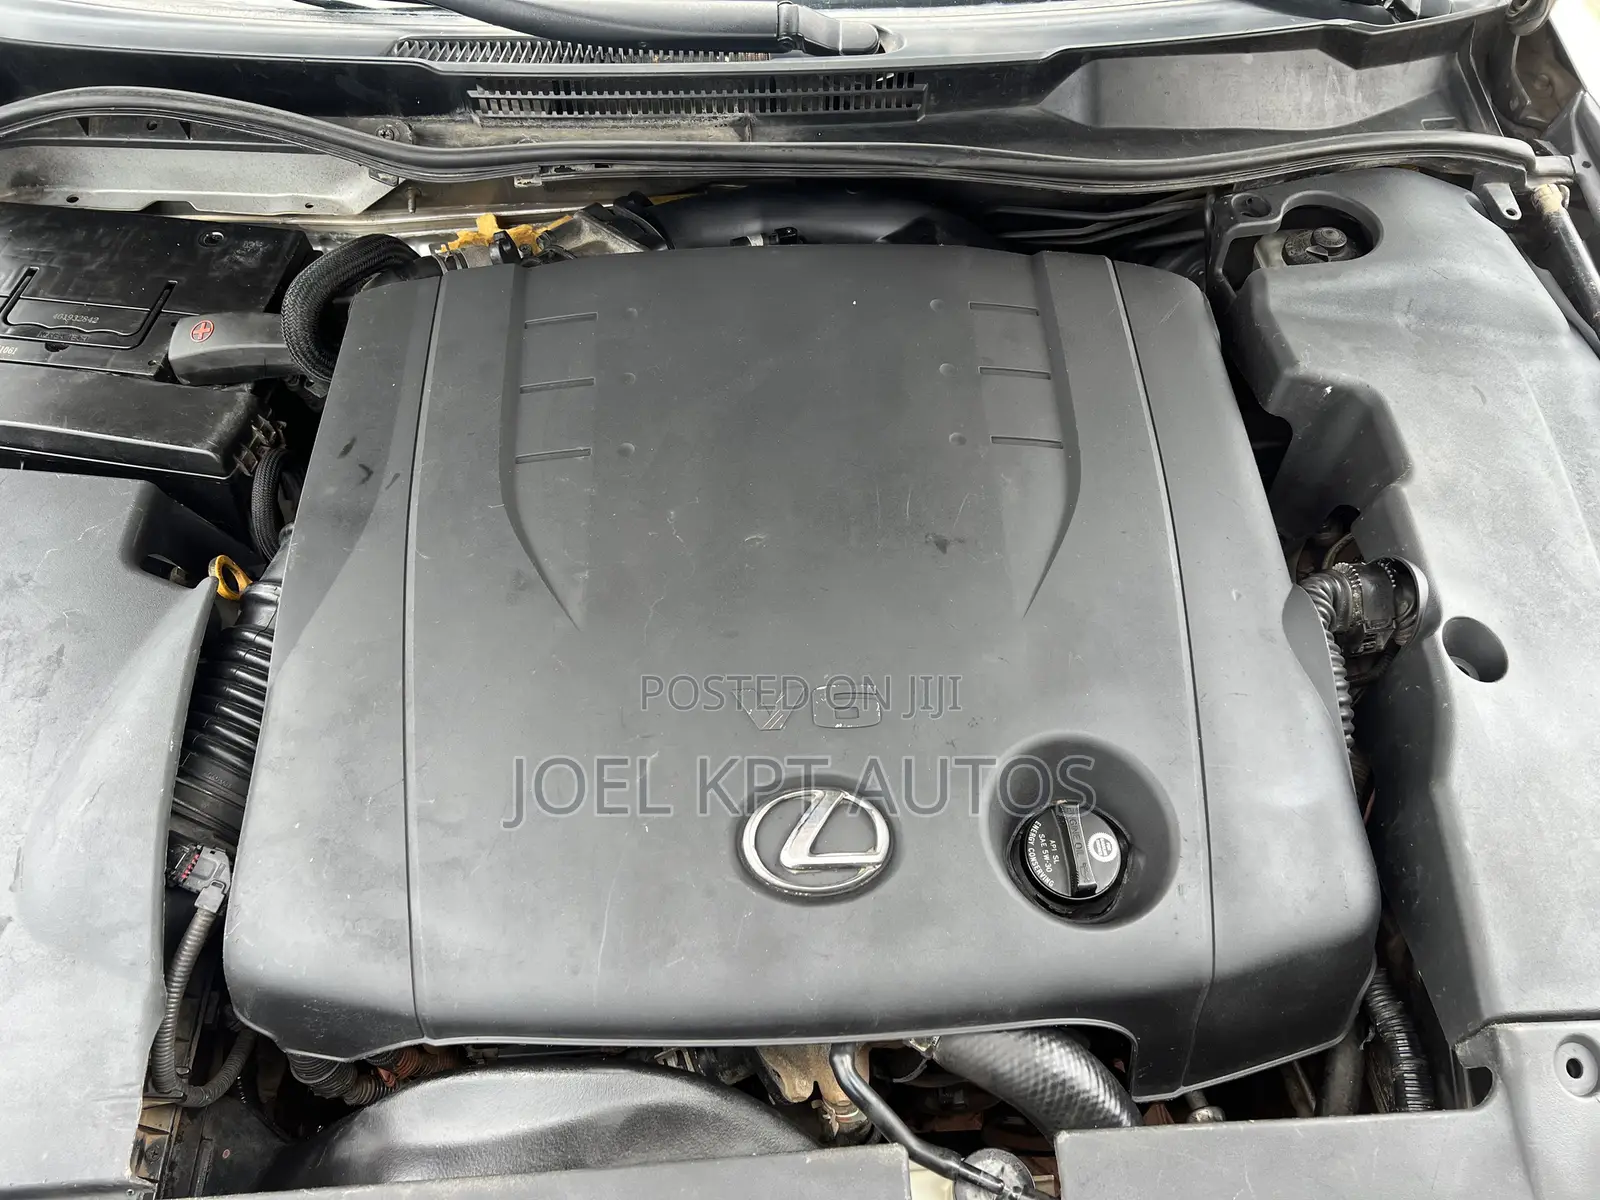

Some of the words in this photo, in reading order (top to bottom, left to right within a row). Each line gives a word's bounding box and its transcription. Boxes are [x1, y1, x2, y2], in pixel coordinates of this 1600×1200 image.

[1027, 820, 1042, 846] ENERGY
[1065, 807, 1081, 839] ENGINE
[1038, 833, 1048, 848] SAE
[1049, 839, 1058, 852] API
[1027, 847, 1055, 888] CONSERVING
[1041, 849, 1053, 873] 5W-30
[1052, 854, 1060, 865] SL
